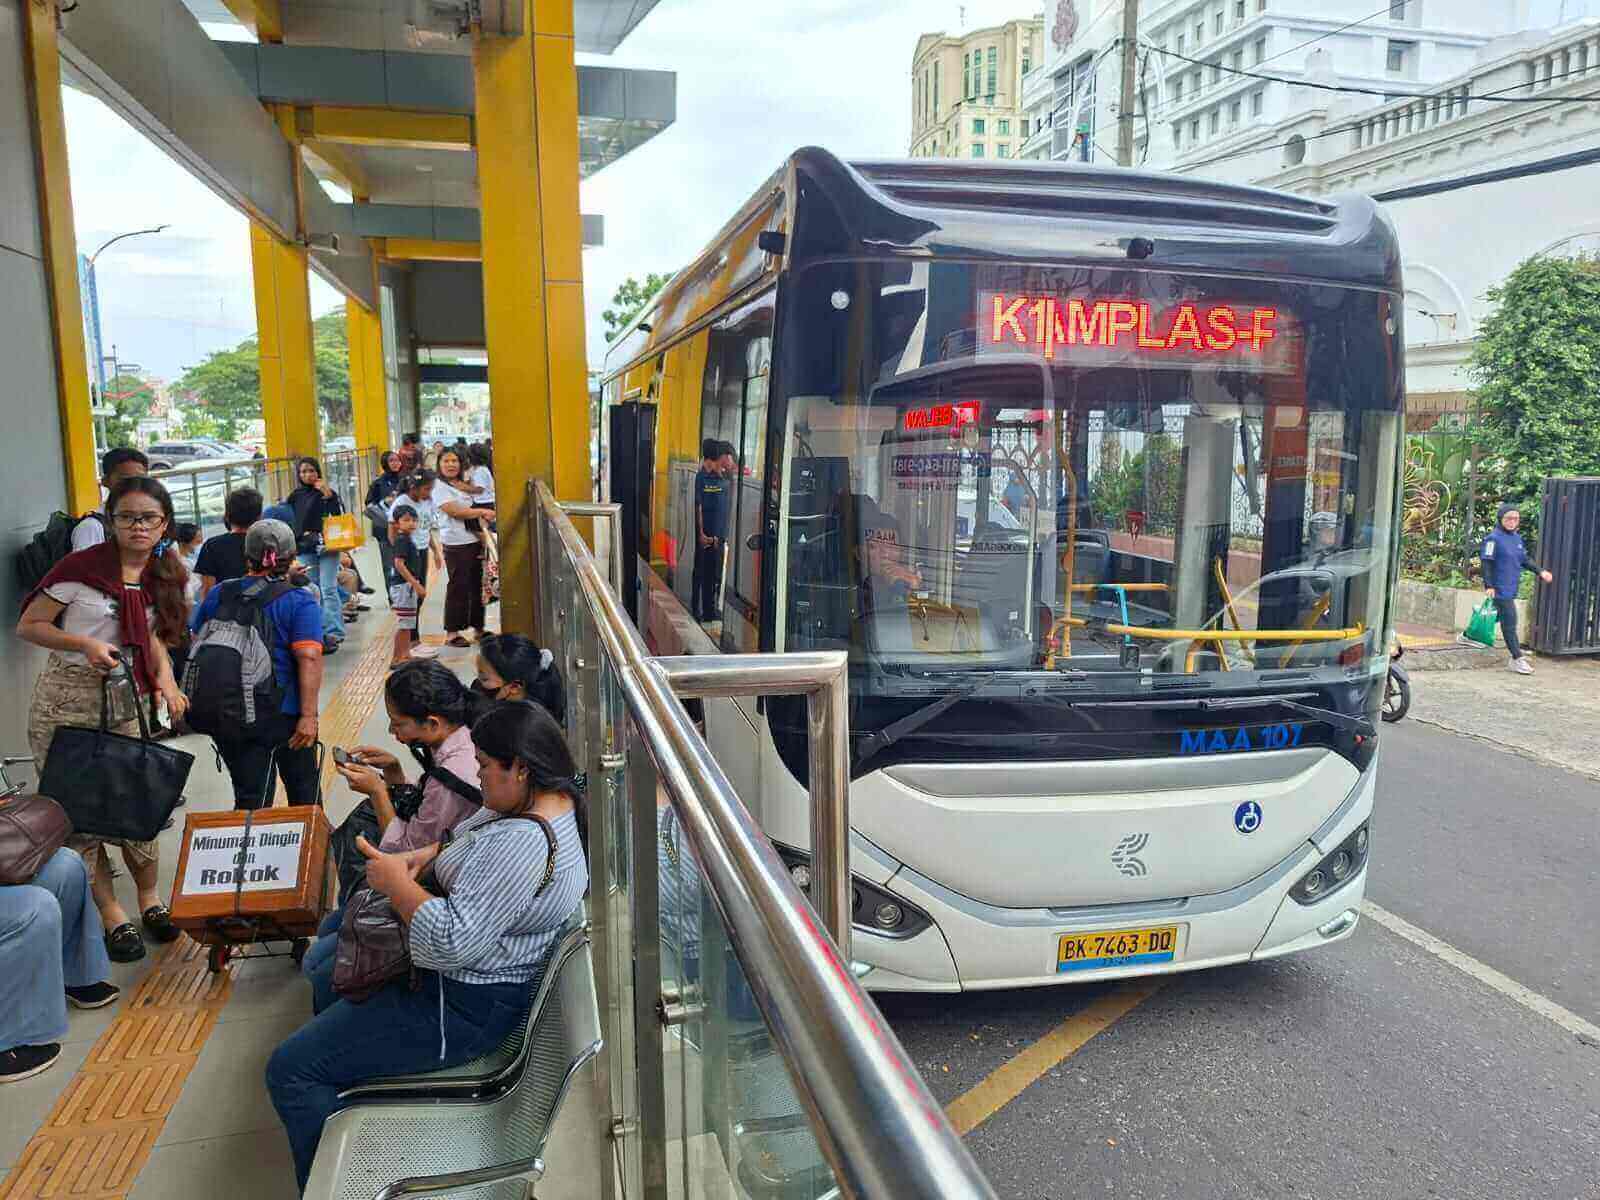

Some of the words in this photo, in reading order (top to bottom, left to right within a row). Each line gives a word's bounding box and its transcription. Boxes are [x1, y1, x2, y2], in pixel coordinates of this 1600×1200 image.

[1181, 727, 1251, 752] MAA
[193, 834, 256, 850] Minuman
[259, 830, 300, 848] Dingin
[200, 865, 279, 885] Rokok
[1065, 940, 1086, 959] BK
[1095, 934, 1139, 956] 7463
